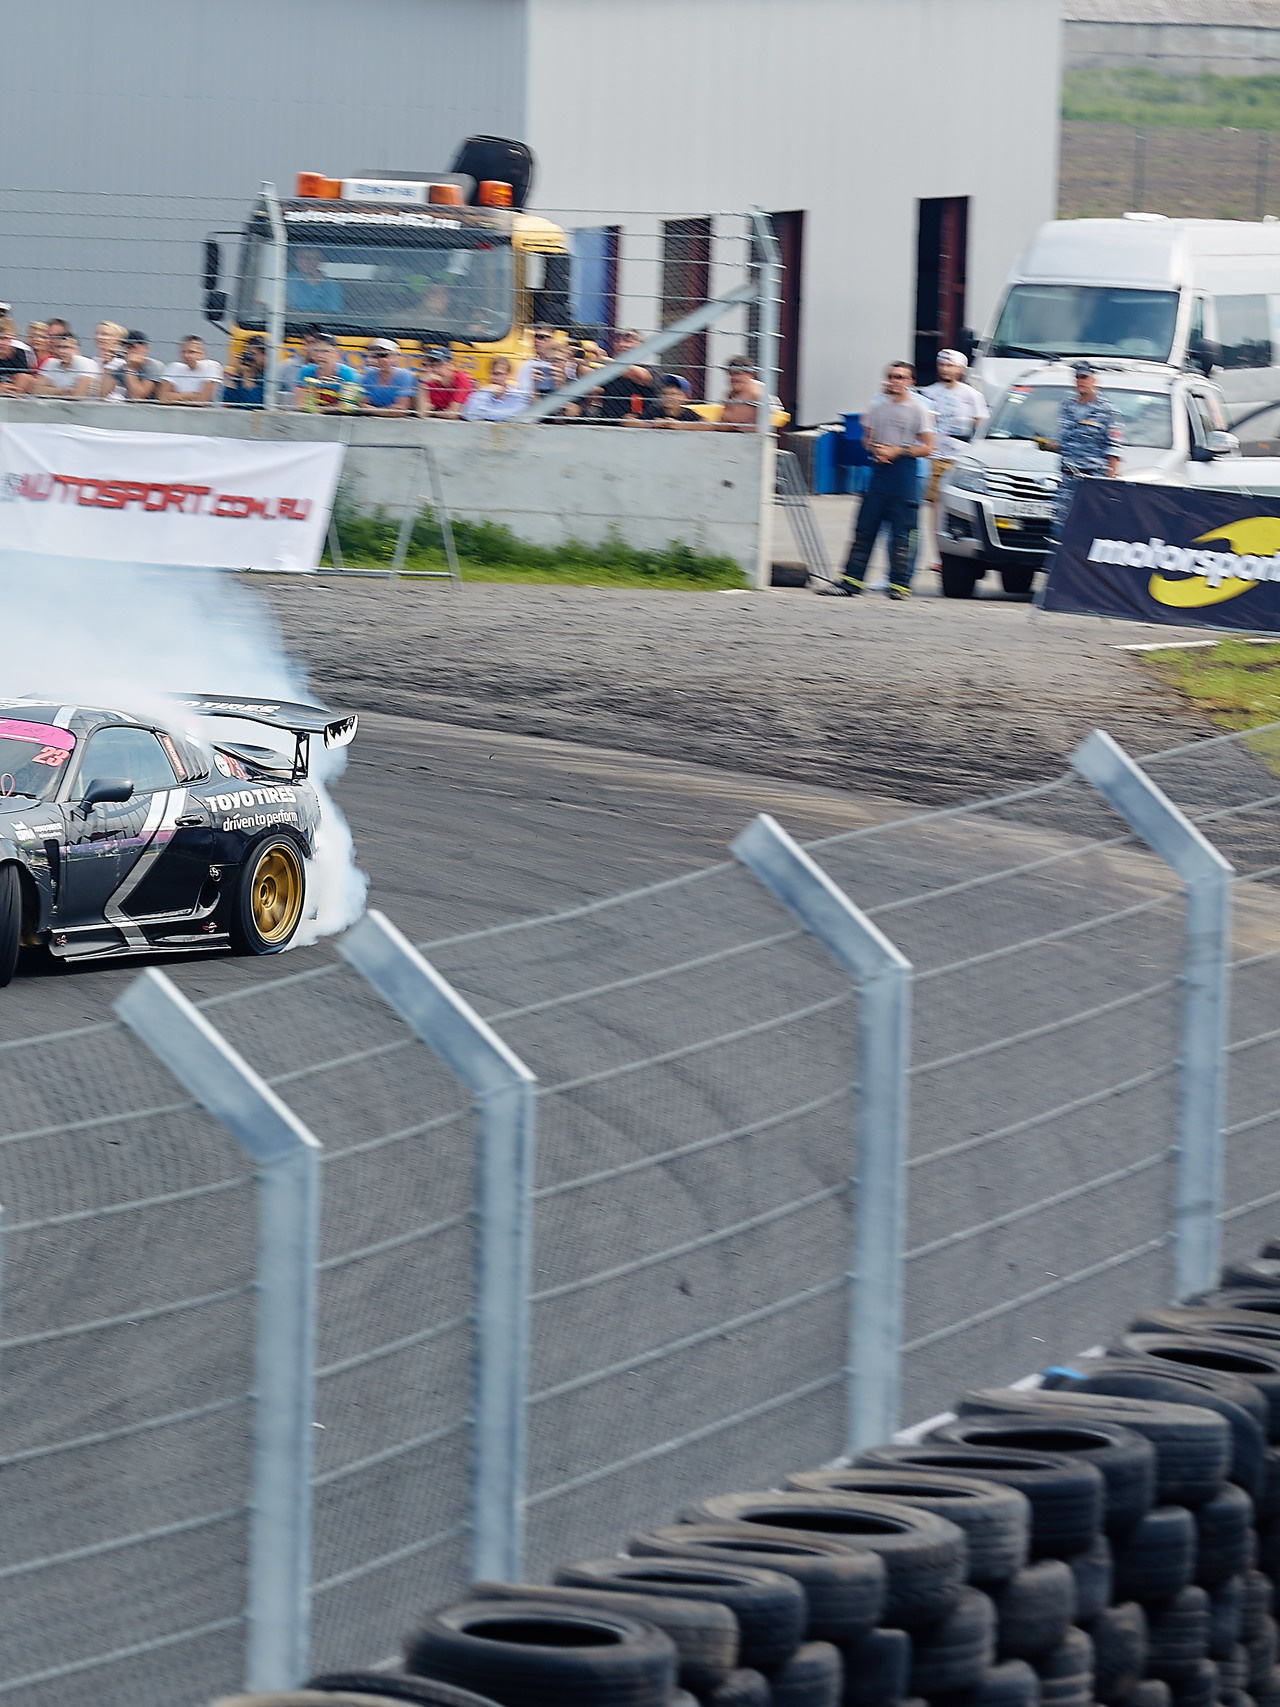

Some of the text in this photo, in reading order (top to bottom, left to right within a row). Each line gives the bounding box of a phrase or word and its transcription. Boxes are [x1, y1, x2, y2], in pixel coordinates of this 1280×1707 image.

[31, 746, 70, 768] 23
[204, 787, 297, 814] TOYO TIRES
[223, 808, 299, 832] driven to perform
